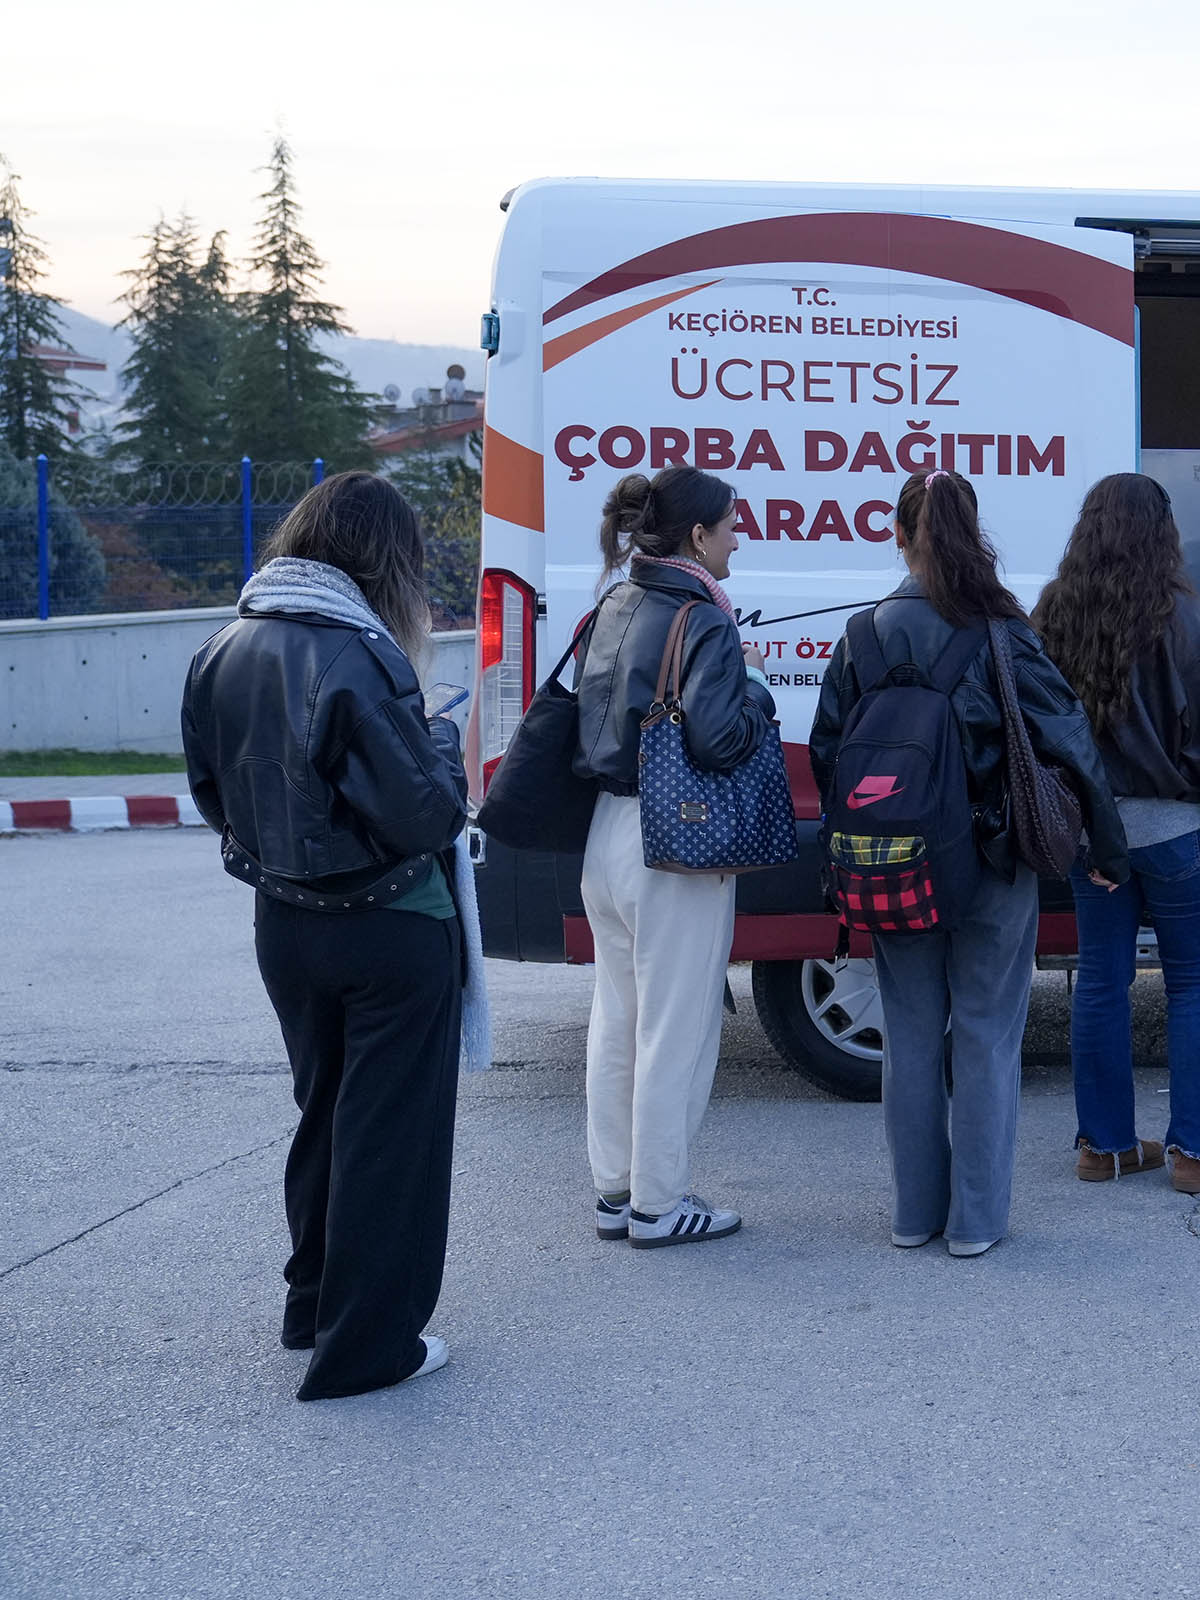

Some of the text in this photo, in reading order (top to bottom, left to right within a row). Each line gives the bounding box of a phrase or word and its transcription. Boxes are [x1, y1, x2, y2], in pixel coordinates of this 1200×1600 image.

[792, 287, 836, 306] T.C.
[668, 309, 958, 339] KEÇİÖREN BELEDİYESİ
[671, 347, 960, 406] ÜCRETSİZ
[554, 420, 1065, 482] ÇORBA DAĞITIM
[765, 675, 790, 685] EN
